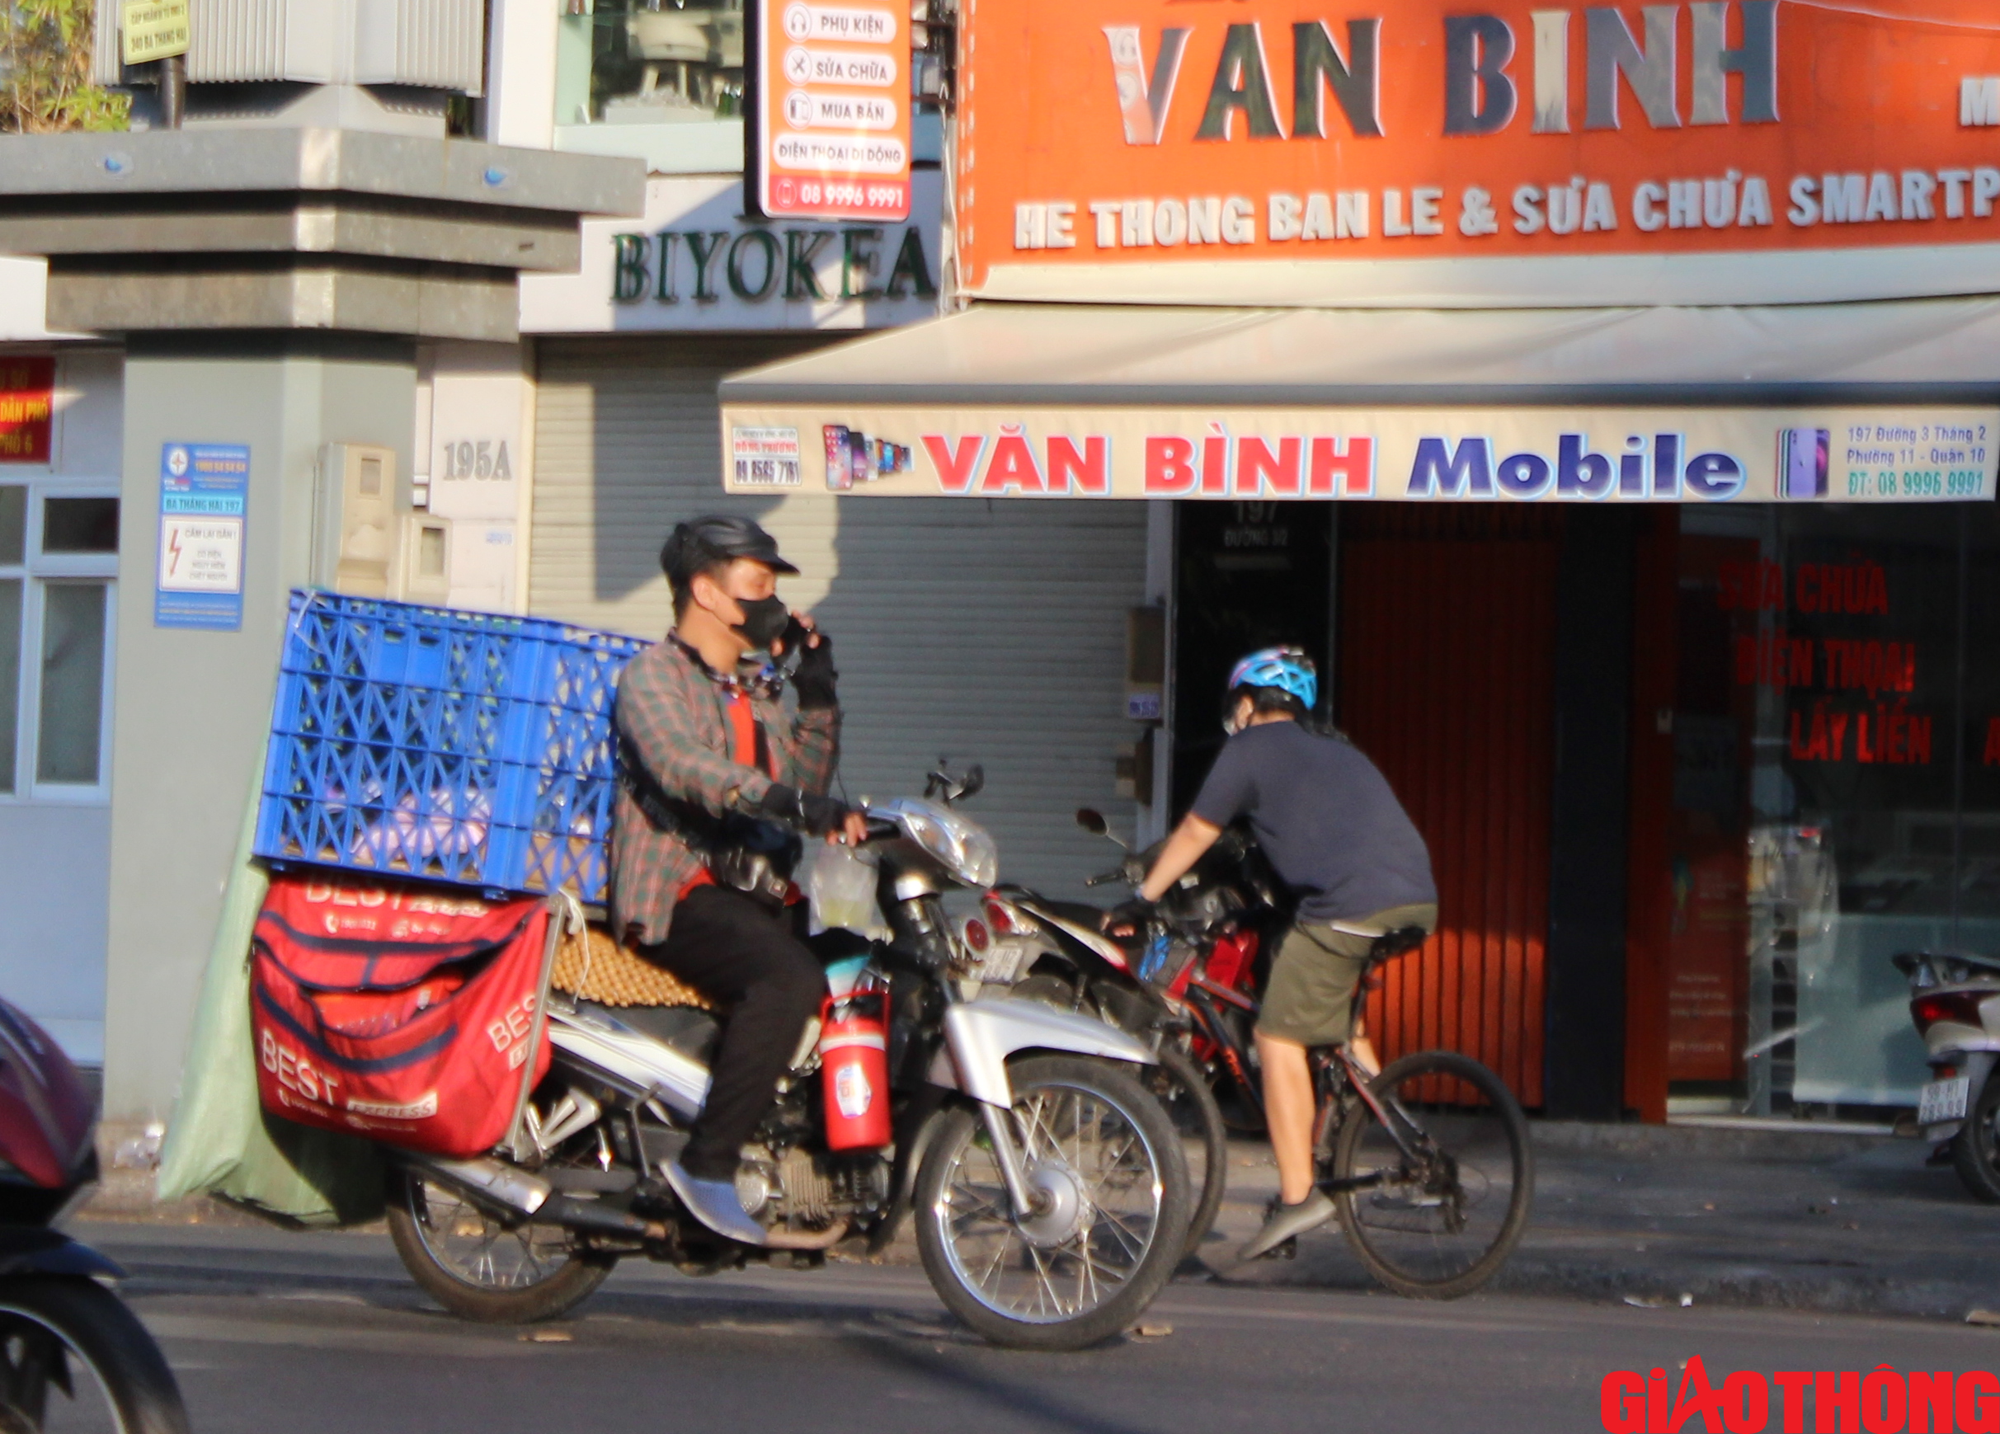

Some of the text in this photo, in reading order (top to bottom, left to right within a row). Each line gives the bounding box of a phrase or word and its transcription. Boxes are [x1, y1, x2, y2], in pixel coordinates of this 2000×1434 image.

[821, 14, 883, 38] PHỤ KIỆN
[816, 57, 888, 81] SỬA CHỮA
[821, 102, 884, 121] MUA BÁN
[779, 141, 808, 162] ĐIỆN
[801, 184, 903, 208] 08 9996 9991
[1459, 185, 1498, 236] &
[610, 226, 938, 305] BIYOKEA
[1848, 425, 1986, 444] 197 Đường 3 Tháng 2
[443, 440, 512, 481] 195A
[920, 421, 1746, 499] VĂN BÌNH Mobile
[1847, 448, 1895, 467] Phường
[1900, 449, 1914, 463] 11
[1930, 448, 1965, 467] Quận
[1970, 448, 1986, 463] 10
[1848, 471, 1983, 496] ĐT: 08 9996 9991
[225, 500, 240, 512] 197
[262, 1028, 338, 1106] BEST
[350, 1098, 434, 1118] EXPRESS
